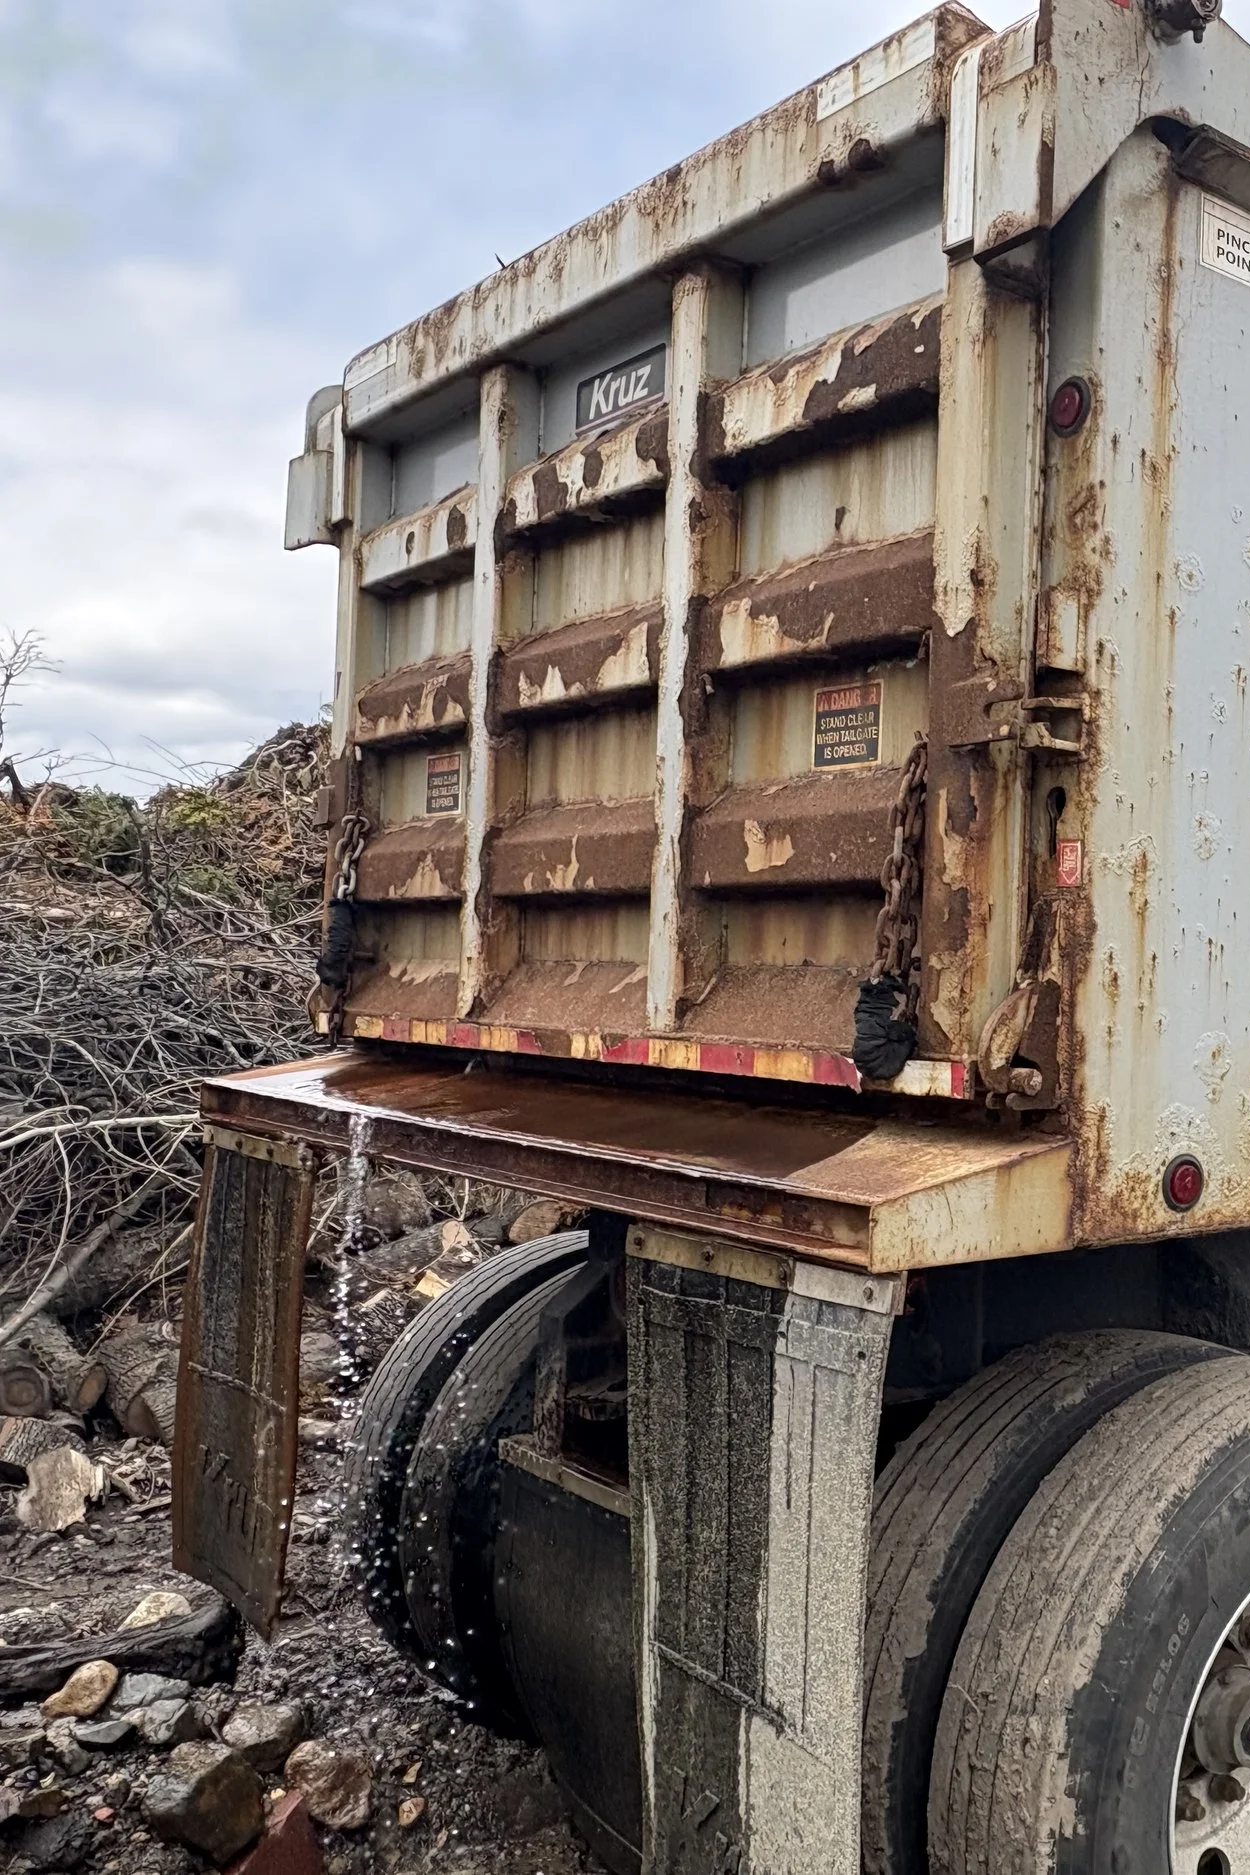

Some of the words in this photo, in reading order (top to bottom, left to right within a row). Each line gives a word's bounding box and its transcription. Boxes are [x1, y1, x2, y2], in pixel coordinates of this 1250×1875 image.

[588, 364, 652, 420] Kruz
[831, 687, 879, 711] DANG
[823, 746, 832, 759] IS
